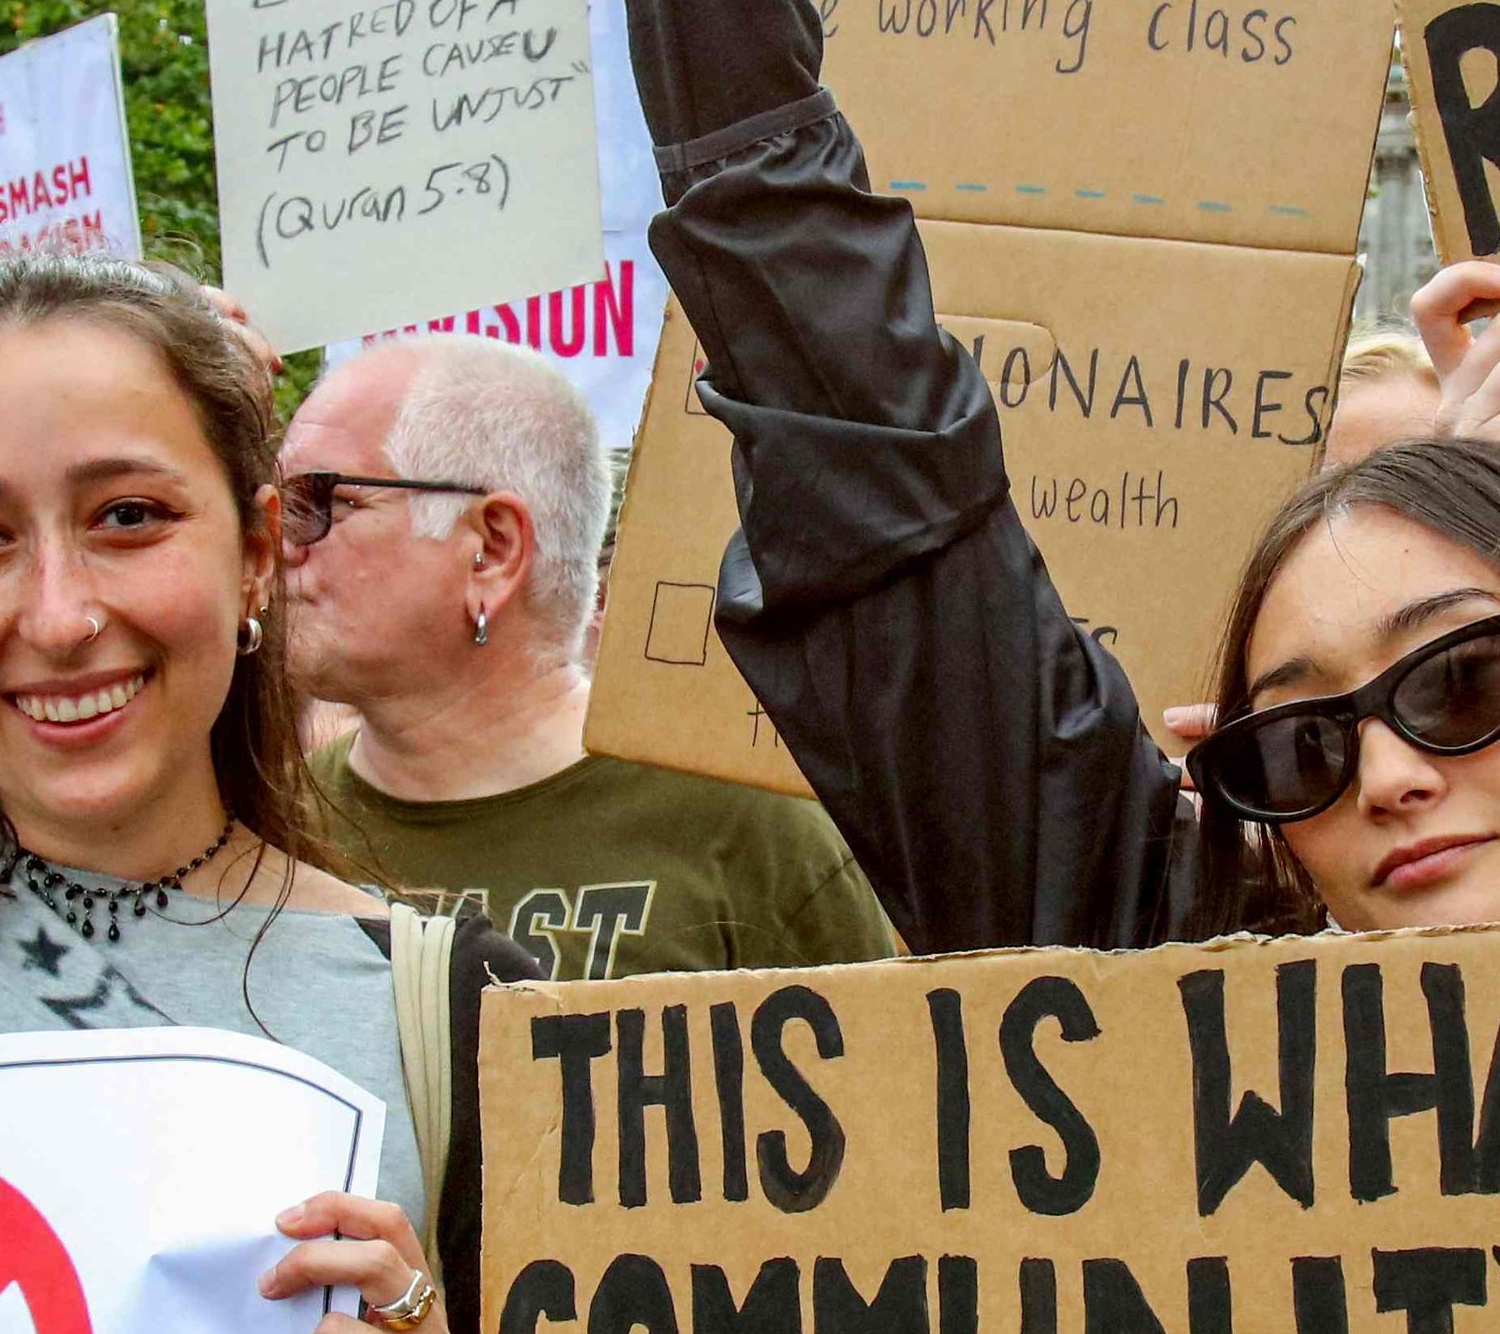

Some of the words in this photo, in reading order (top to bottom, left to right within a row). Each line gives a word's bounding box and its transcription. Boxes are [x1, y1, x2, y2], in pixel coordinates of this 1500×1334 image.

[269, 56, 402, 127] PEOPLE
[268, 131, 325, 172] TO
[348, 105, 405, 156] BE
[255, 188, 406, 268] (Quran
[1031, 470, 1178, 529] wealth
[529, 984, 846, 1215] THIS
[925, 974, 1100, 1217] IS
